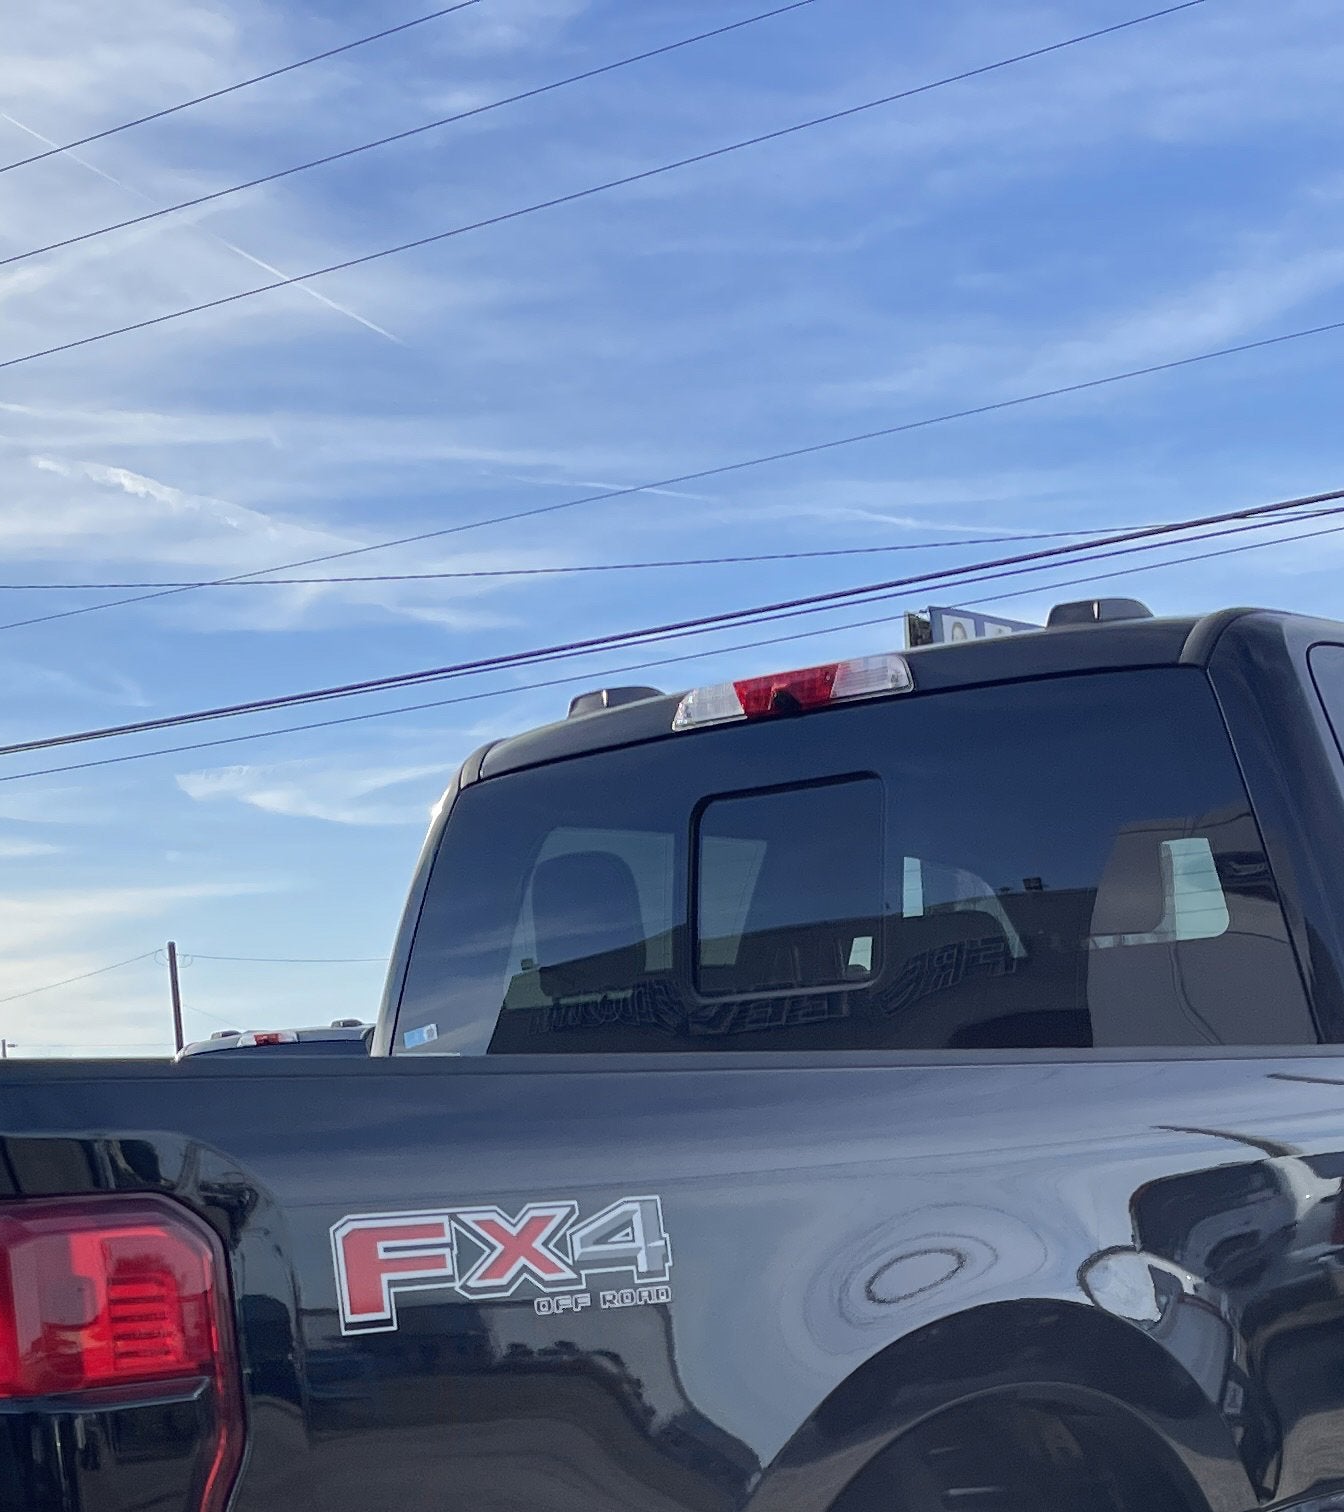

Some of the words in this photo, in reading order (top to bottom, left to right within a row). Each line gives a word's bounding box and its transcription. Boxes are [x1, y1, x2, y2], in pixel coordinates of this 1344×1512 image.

[330, 1195, 673, 1336] FX4
[534, 1293, 591, 1315] OFF
[600, 1285, 672, 1309] ROAD
